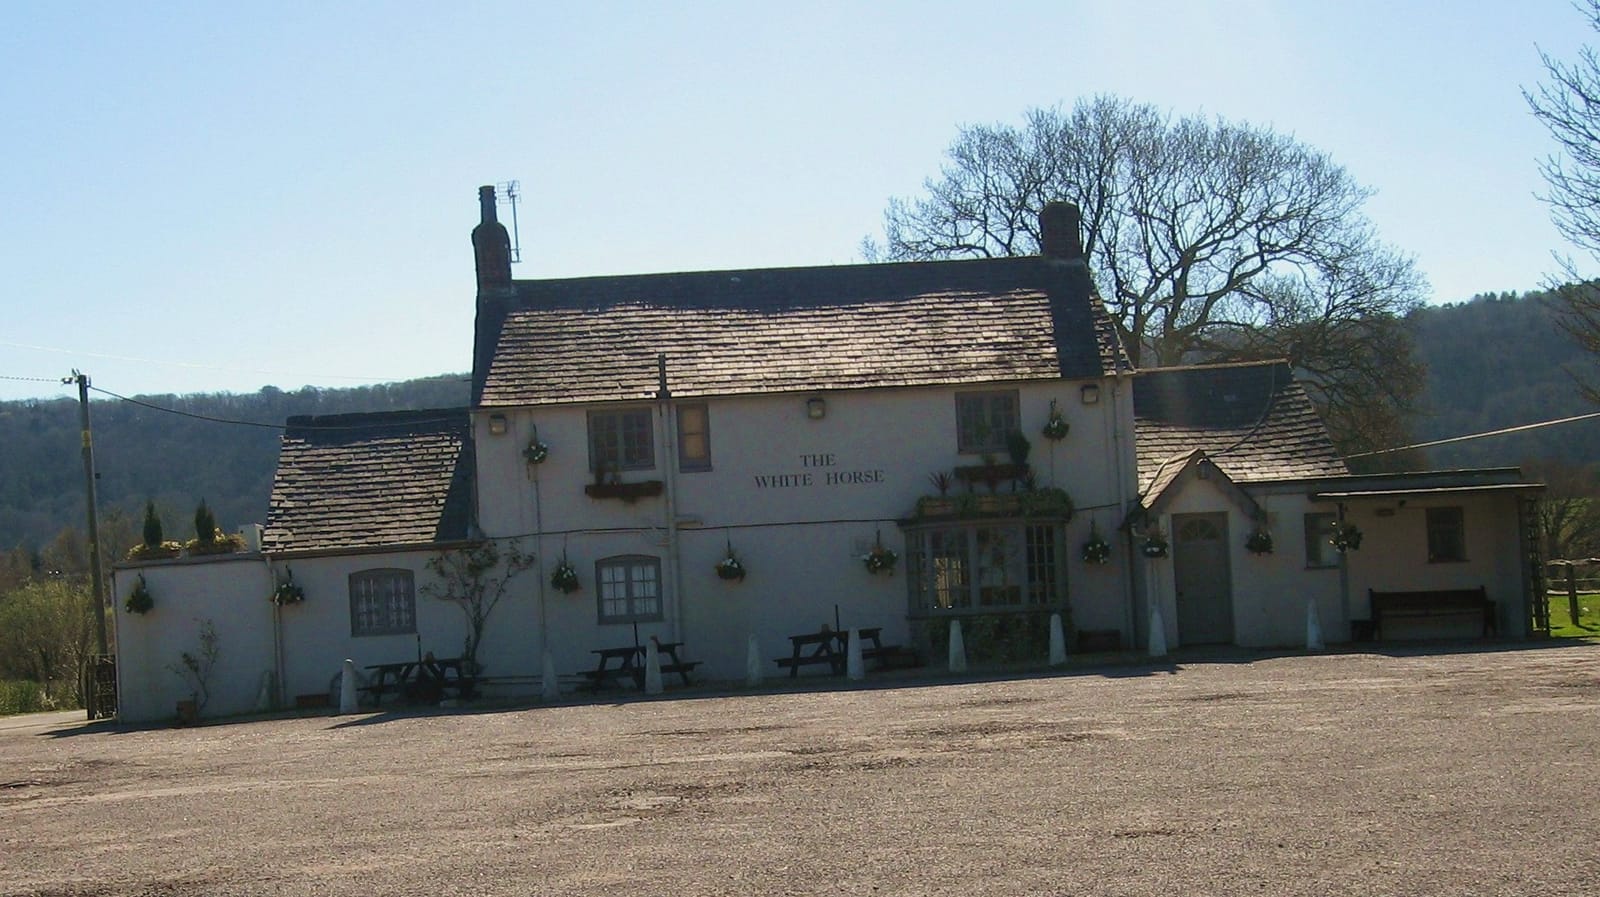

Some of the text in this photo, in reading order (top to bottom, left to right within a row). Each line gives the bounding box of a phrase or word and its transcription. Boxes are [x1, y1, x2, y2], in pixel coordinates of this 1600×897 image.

[800, 453, 836, 467] THE
[754, 469, 885, 488] WHITE HORSE
